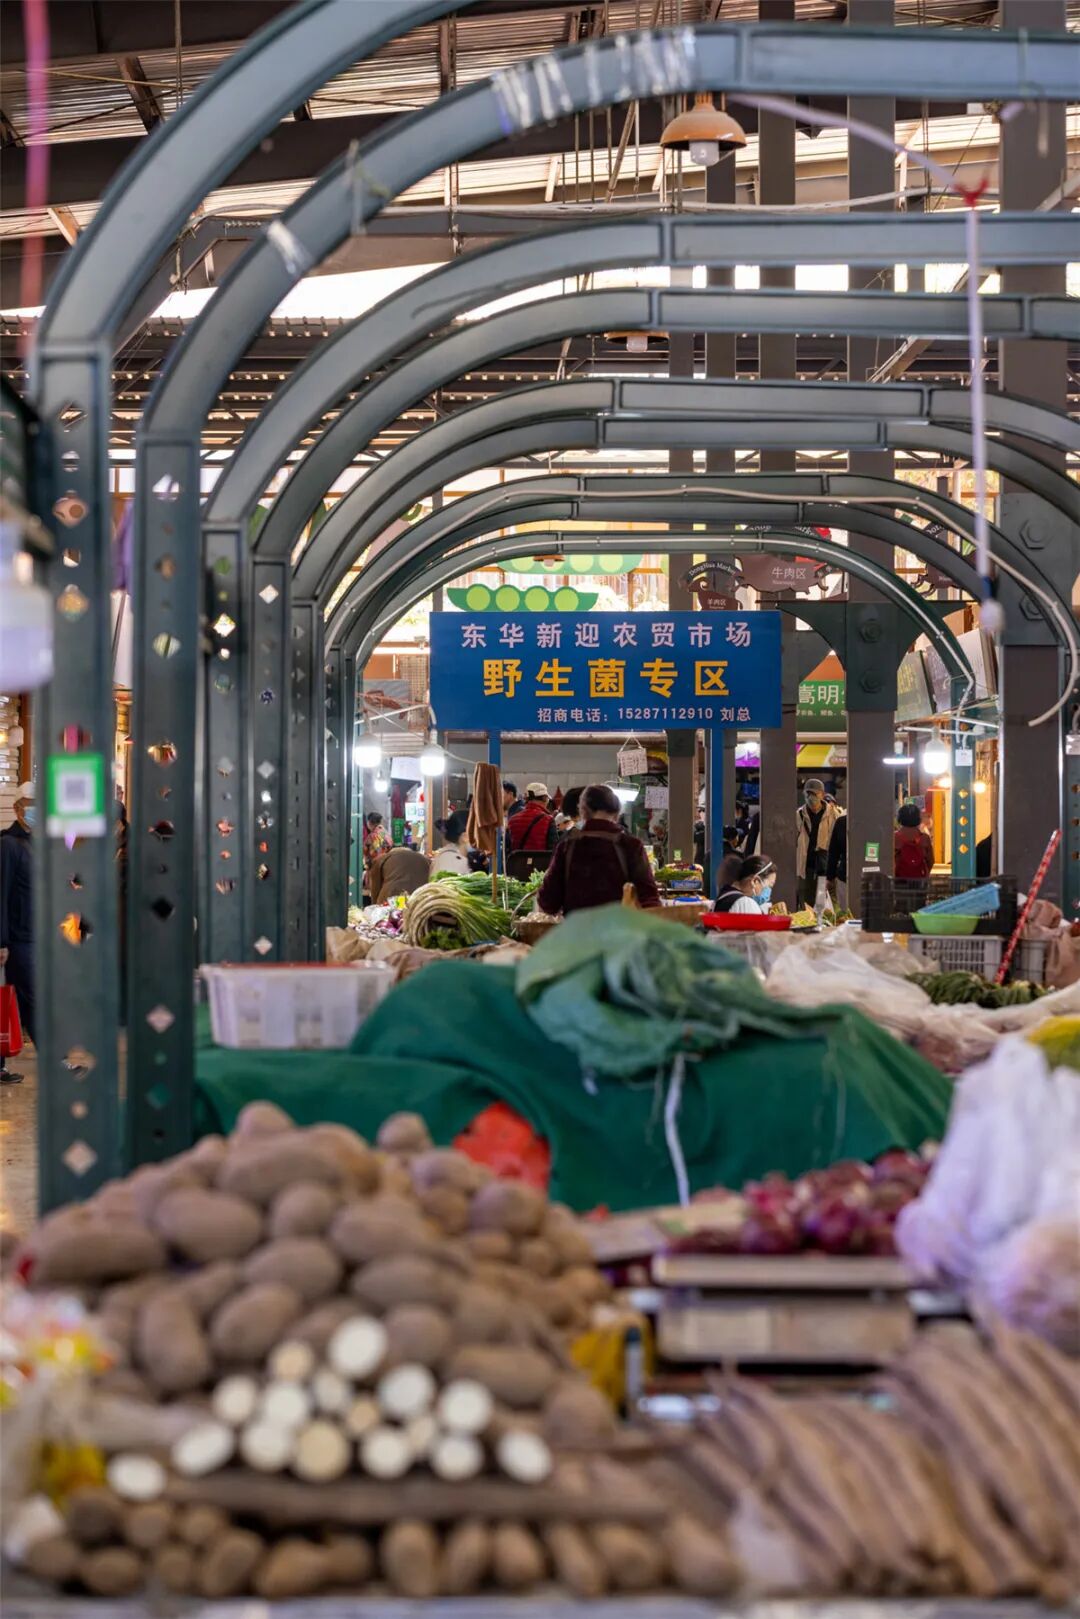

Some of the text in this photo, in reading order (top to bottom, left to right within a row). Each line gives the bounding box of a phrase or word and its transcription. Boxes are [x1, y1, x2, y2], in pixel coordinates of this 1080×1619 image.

[771, 566, 806, 580] 牛肉区
[461, 622, 751, 648] 东华新迎农贸市场
[483, 658, 730, 698] 野生菌专区
[799, 684, 845, 704] 嵩明
[618, 707, 713, 720] 15287112910
[720, 708, 751, 722] 刘总
